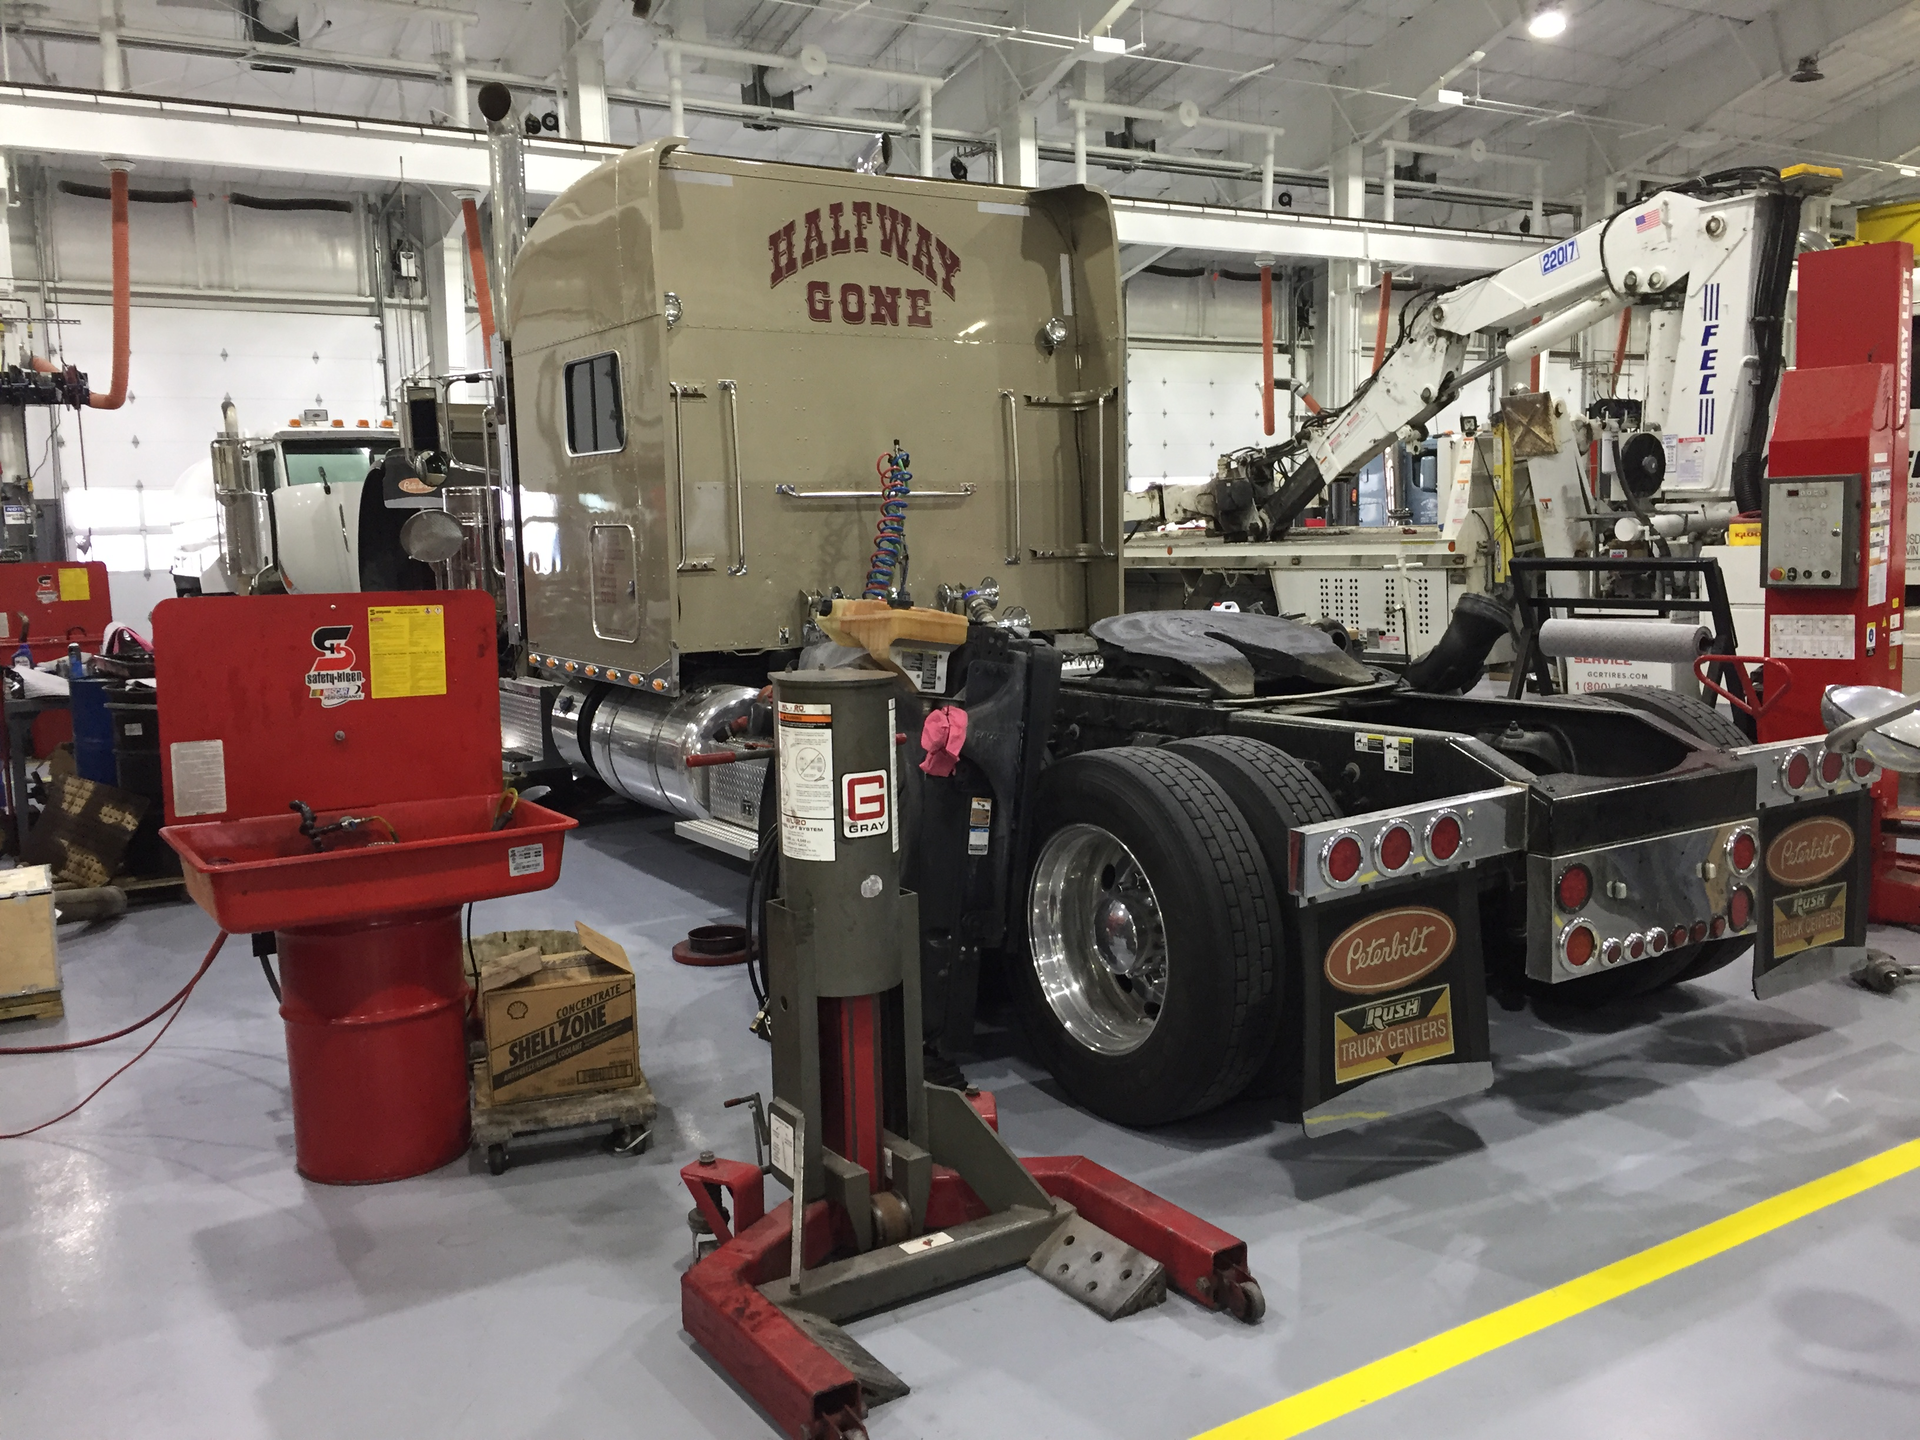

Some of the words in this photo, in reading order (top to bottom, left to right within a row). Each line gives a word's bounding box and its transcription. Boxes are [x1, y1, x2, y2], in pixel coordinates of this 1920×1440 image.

[769, 201, 961, 301] HALFWAY
[1543, 241, 1575, 273] 22017
[805, 281, 933, 328] GONE
[1902, 266, 1910, 320] LIFT
[1699, 324, 1719, 395] FEC
[1587, 671, 1648, 680] GCRTIRES.COM
[849, 821, 885, 834] GRAY
[1781, 834, 1841, 870] Peterbilt
[1777, 918, 1804, 941] TRUCK
[1805, 911, 1842, 934] CENTERS
[1346, 926, 1435, 975] Peterbilt
[556, 983, 621, 1019] CONCENTRATE
[1363, 997, 1421, 1032] RUSH
[1341, 1033, 1385, 1062] TRUCK
[1387, 1018, 1447, 1049] CENTERS
